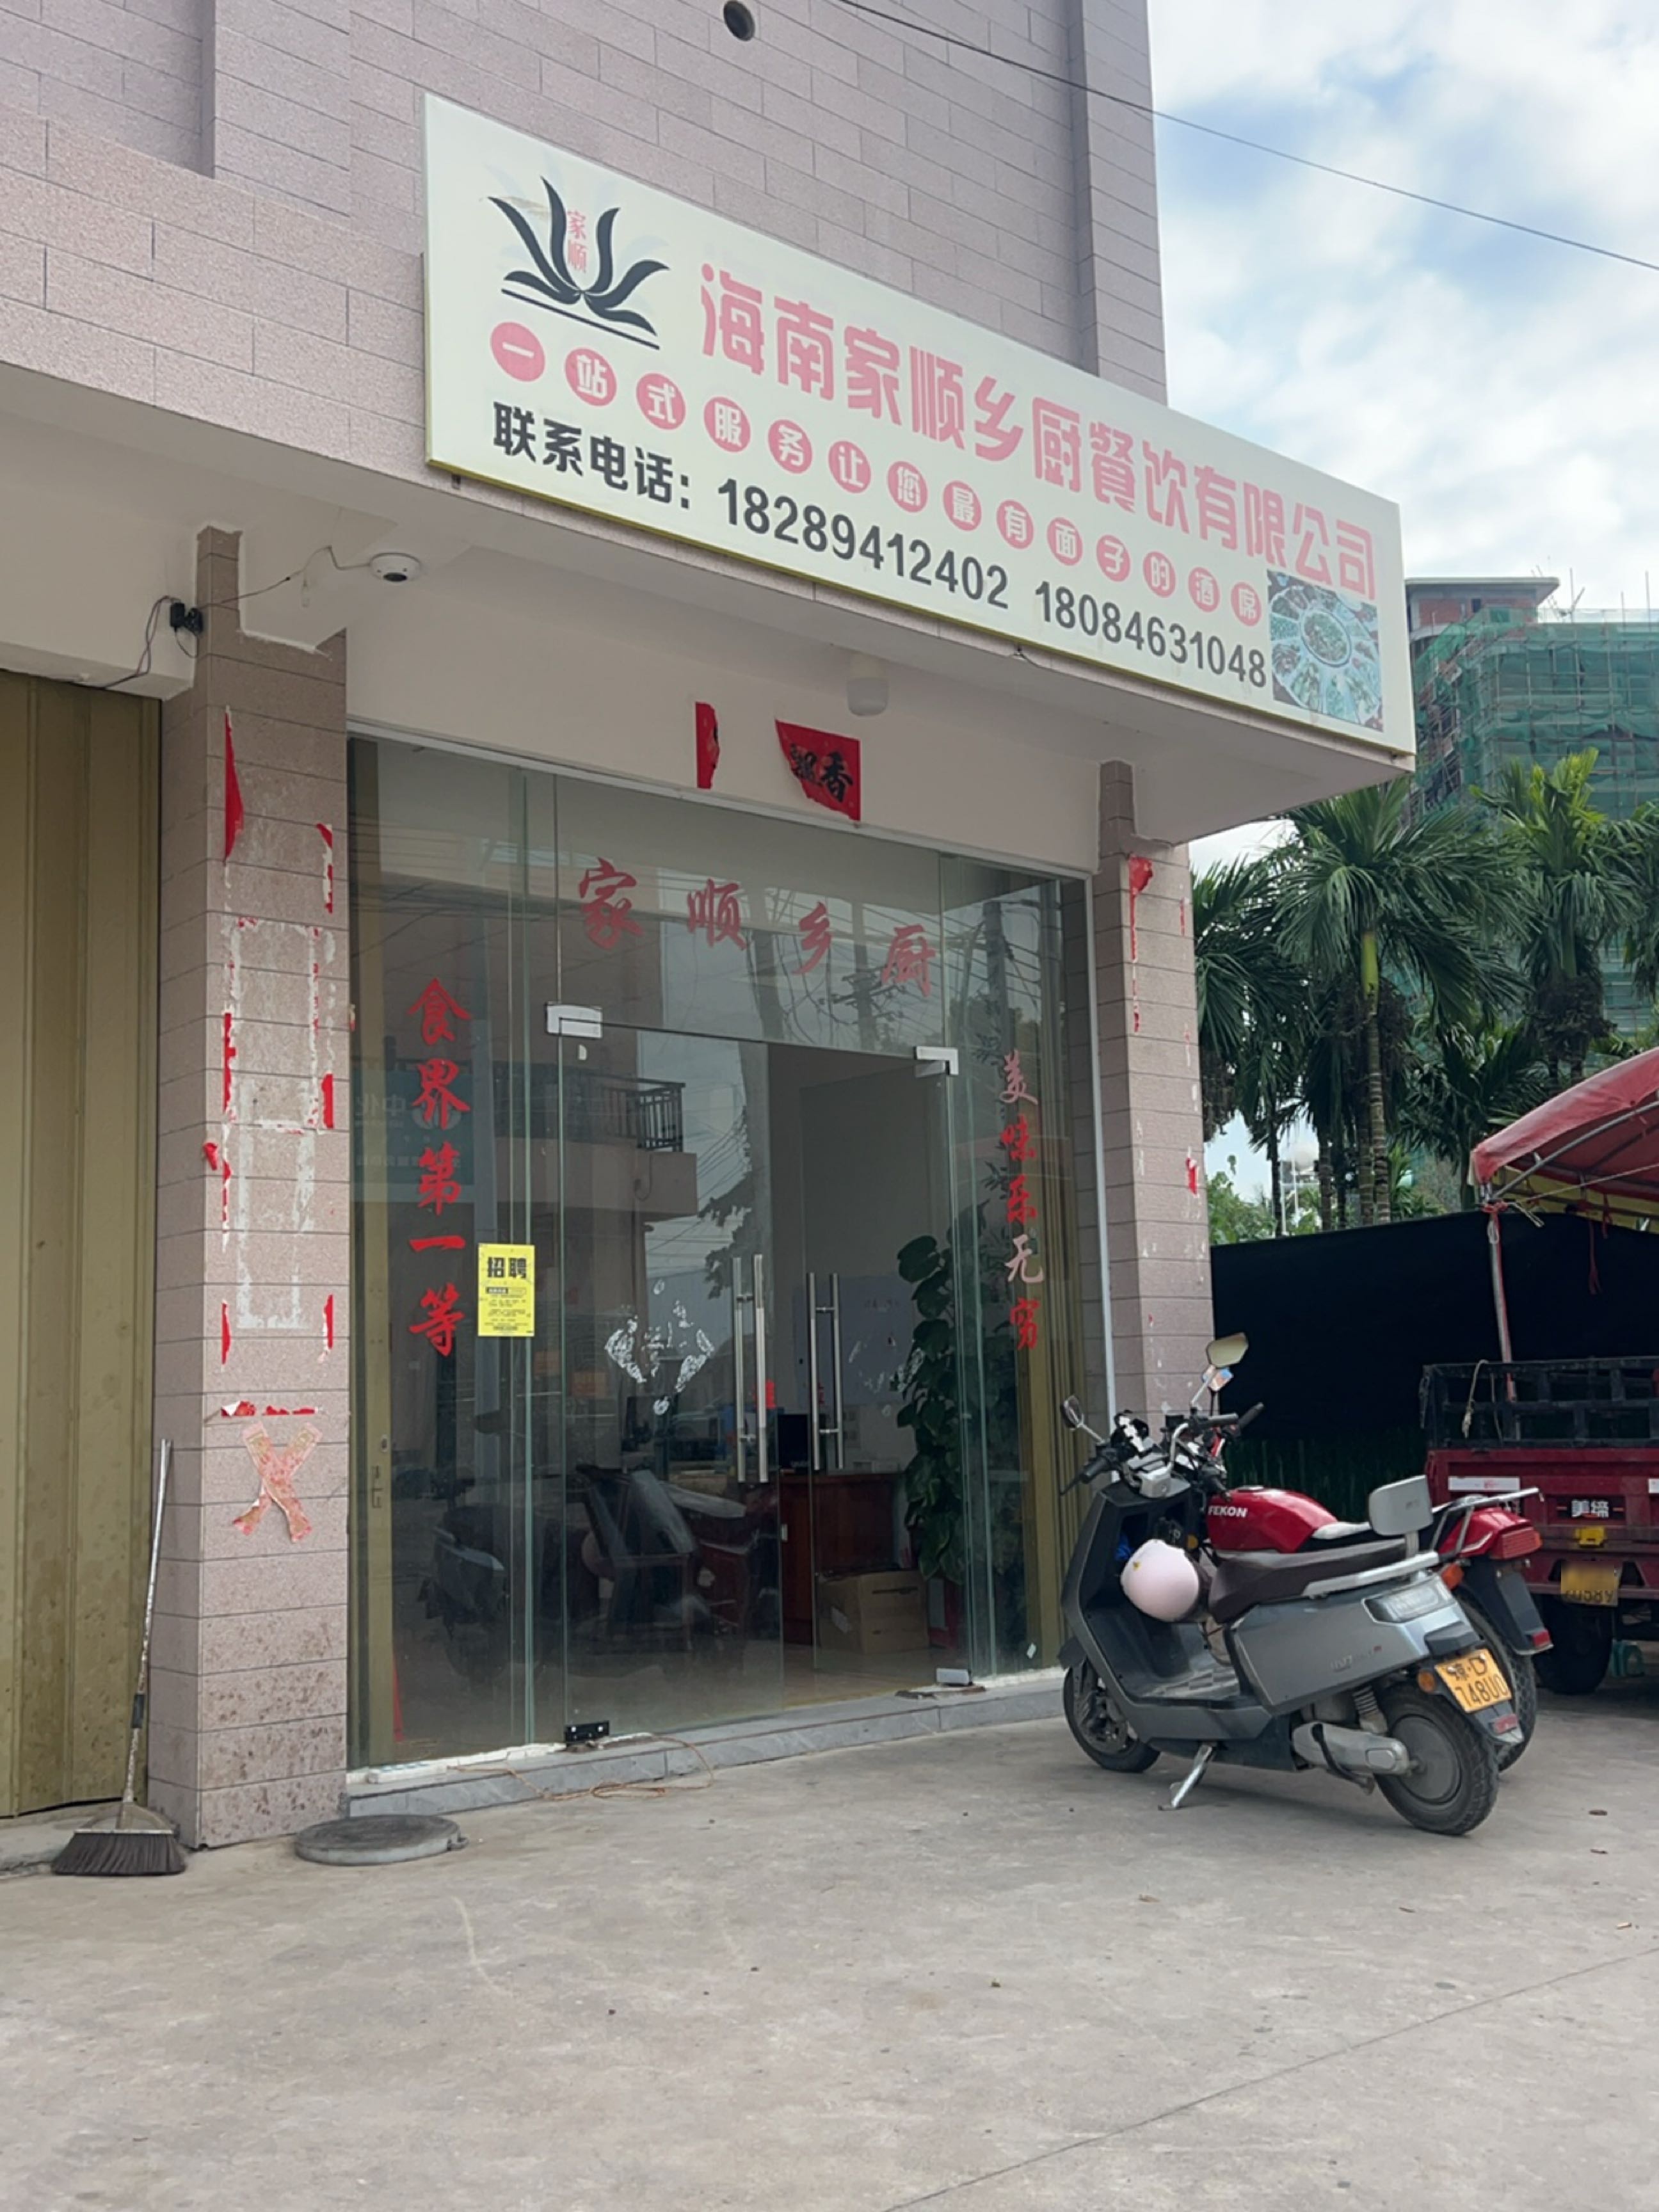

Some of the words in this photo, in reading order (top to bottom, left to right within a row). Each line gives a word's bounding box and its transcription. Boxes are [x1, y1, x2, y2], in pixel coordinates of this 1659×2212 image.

[501, 341, 1257, 621] 一站式服务让您最有面子的酒席
[701, 262, 1375, 600] 海南家顺乡厨餐饮有限公司
[718, 478, 1009, 609] 18289412402
[1035, 581, 1267, 688] 18084631048
[579, 857, 936, 998] 家顺乡厨
[407, 977, 472, 1356] 食界第一等
[487, 1256, 527, 1279] 招聘
[999, 1048, 1045, 1350] 美味乐无穷
[1207, 1505, 1249, 1519] FEKON
